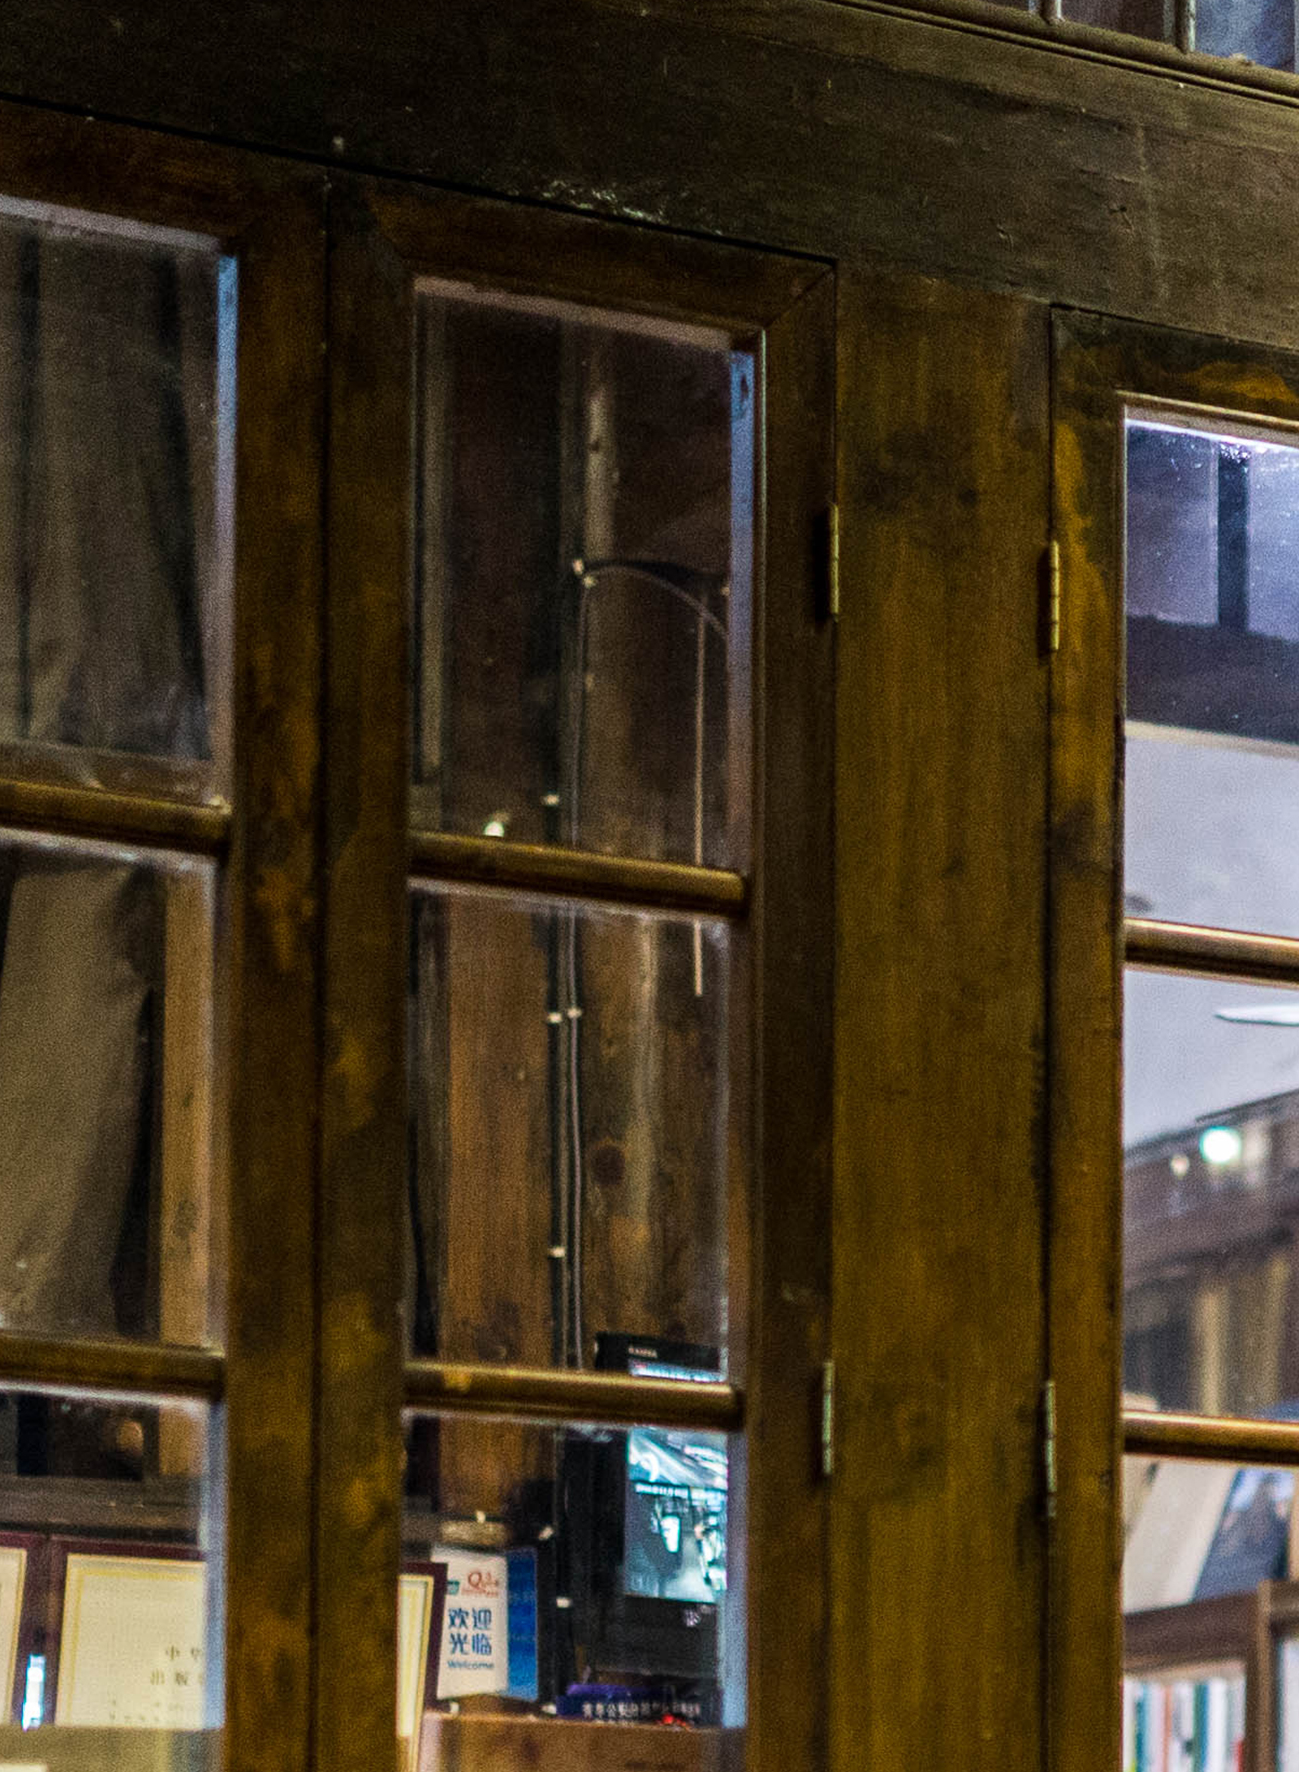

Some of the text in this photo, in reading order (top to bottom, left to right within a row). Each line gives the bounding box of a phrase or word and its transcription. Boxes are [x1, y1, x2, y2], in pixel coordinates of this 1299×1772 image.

[447, 1606, 493, 1630] 欢迎
[449, 1632, 493, 1656] 光临
[447, 1658, 495, 1672] Welcome
